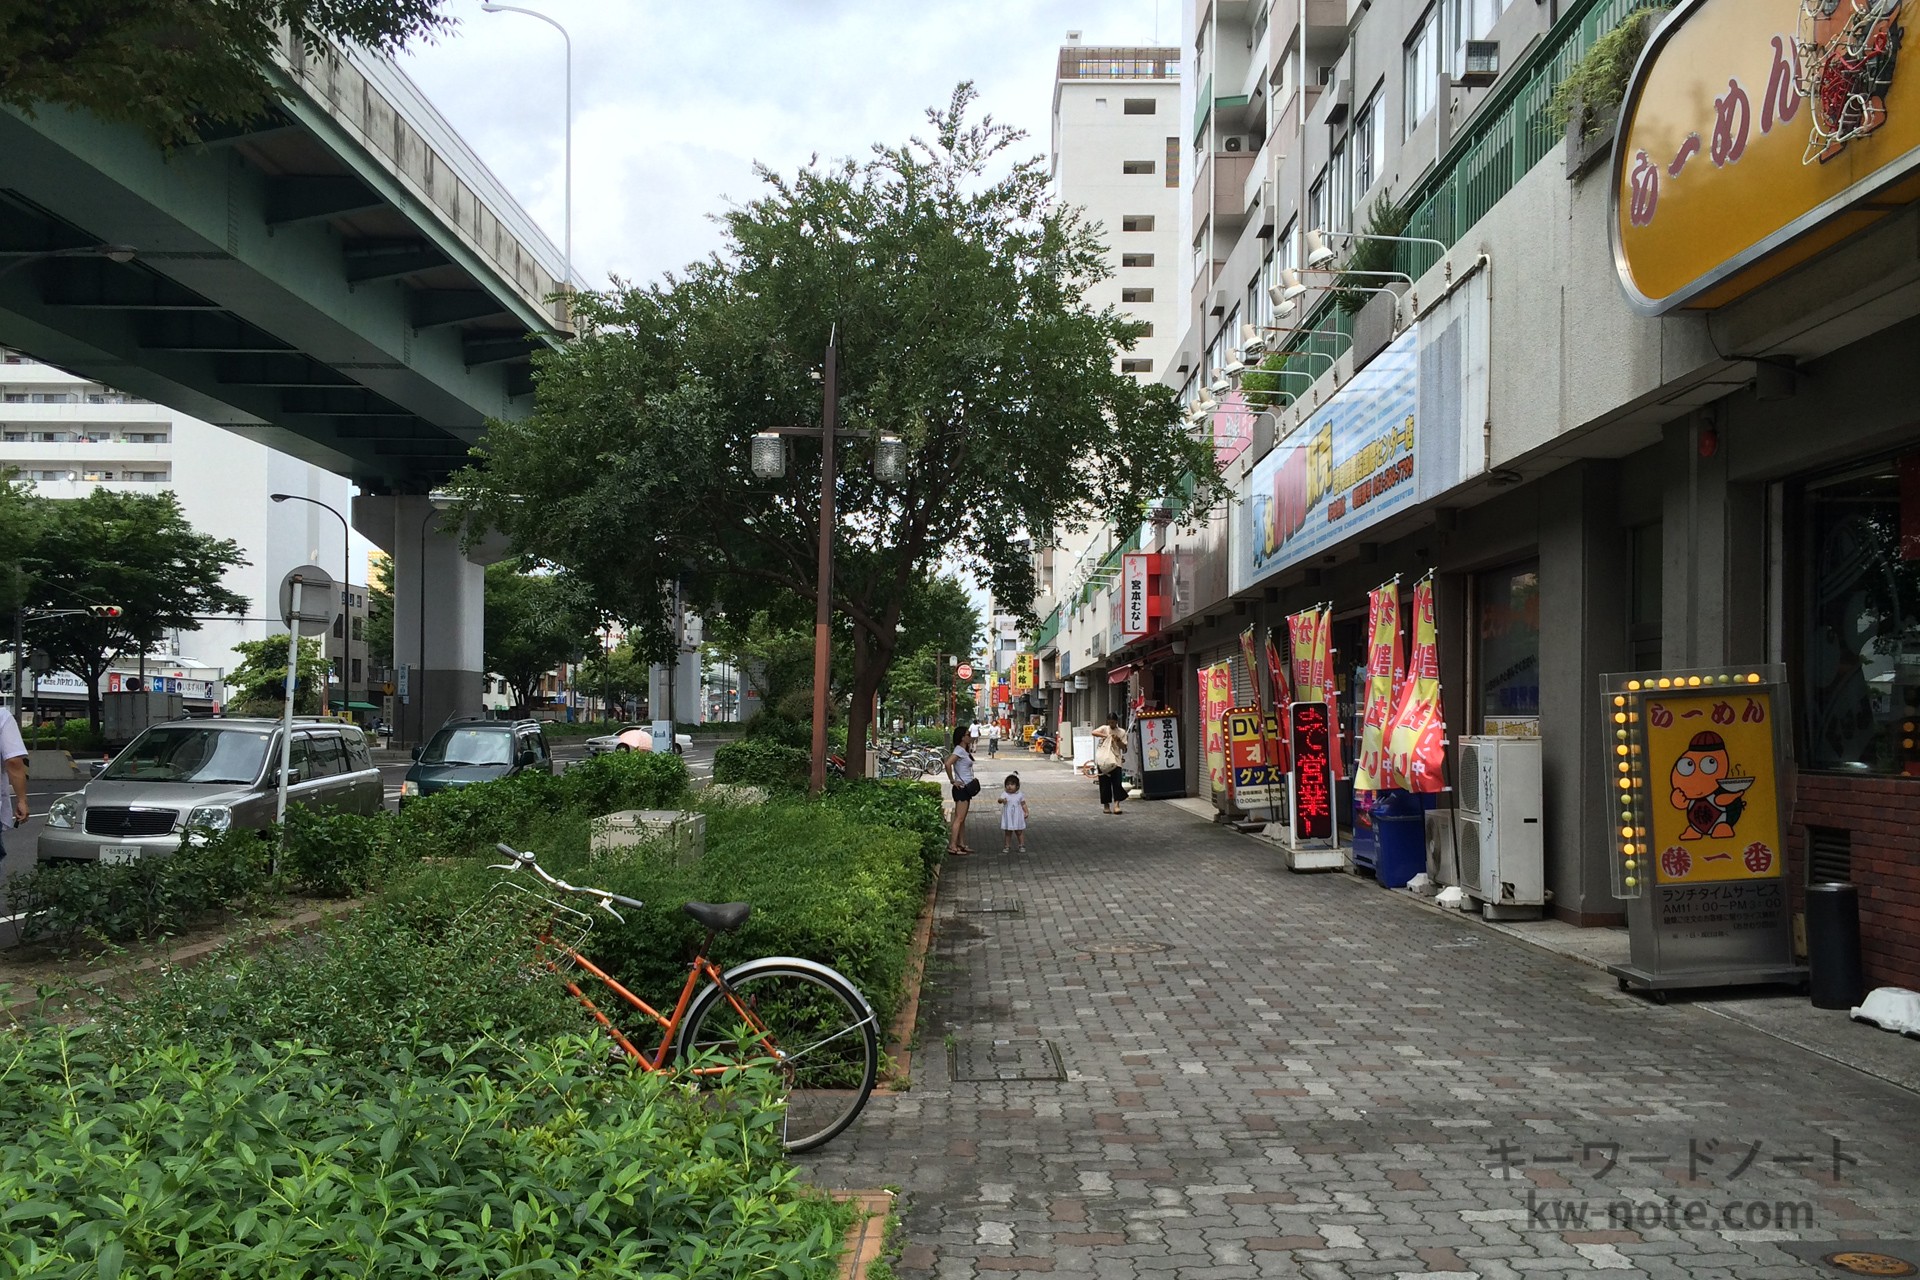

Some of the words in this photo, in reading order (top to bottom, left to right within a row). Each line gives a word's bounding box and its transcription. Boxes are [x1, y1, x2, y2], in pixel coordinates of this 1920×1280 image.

[1630, 35, 1804, 226] らーめん
[1130, 580, 1142, 631] 宮本むなし
[1650, 698, 1765, 728] らーめん
[1161, 718, 1175, 769] 宮本むなし
[1239, 767, 1280, 785] グッズ
[1660, 841, 1775, 878] 藤一番
[1662, 884, 1781, 903] ランチタイムサービス
